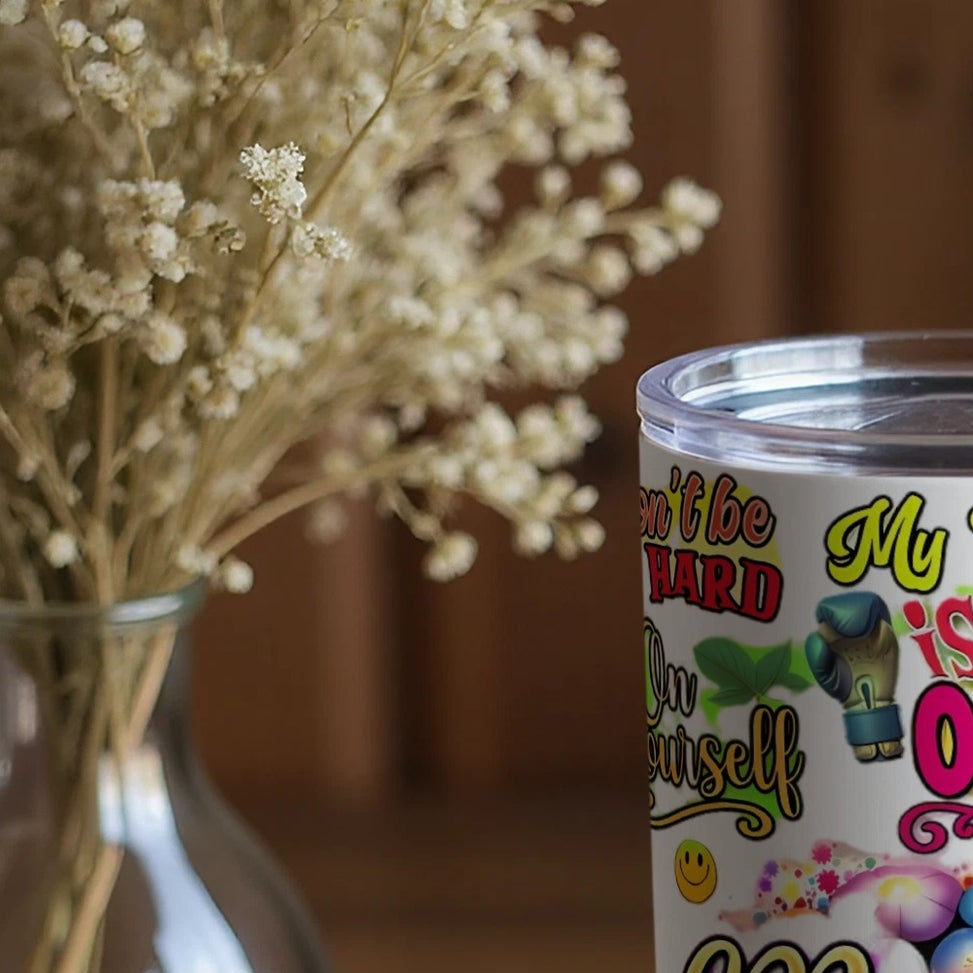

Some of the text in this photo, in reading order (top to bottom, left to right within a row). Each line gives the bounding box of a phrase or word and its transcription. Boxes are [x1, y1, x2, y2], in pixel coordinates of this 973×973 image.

[705, 472, 776, 548] be
[823, 491, 949, 595] My
[644, 542, 784, 623] HARD
[648, 703, 806, 821] ourself
